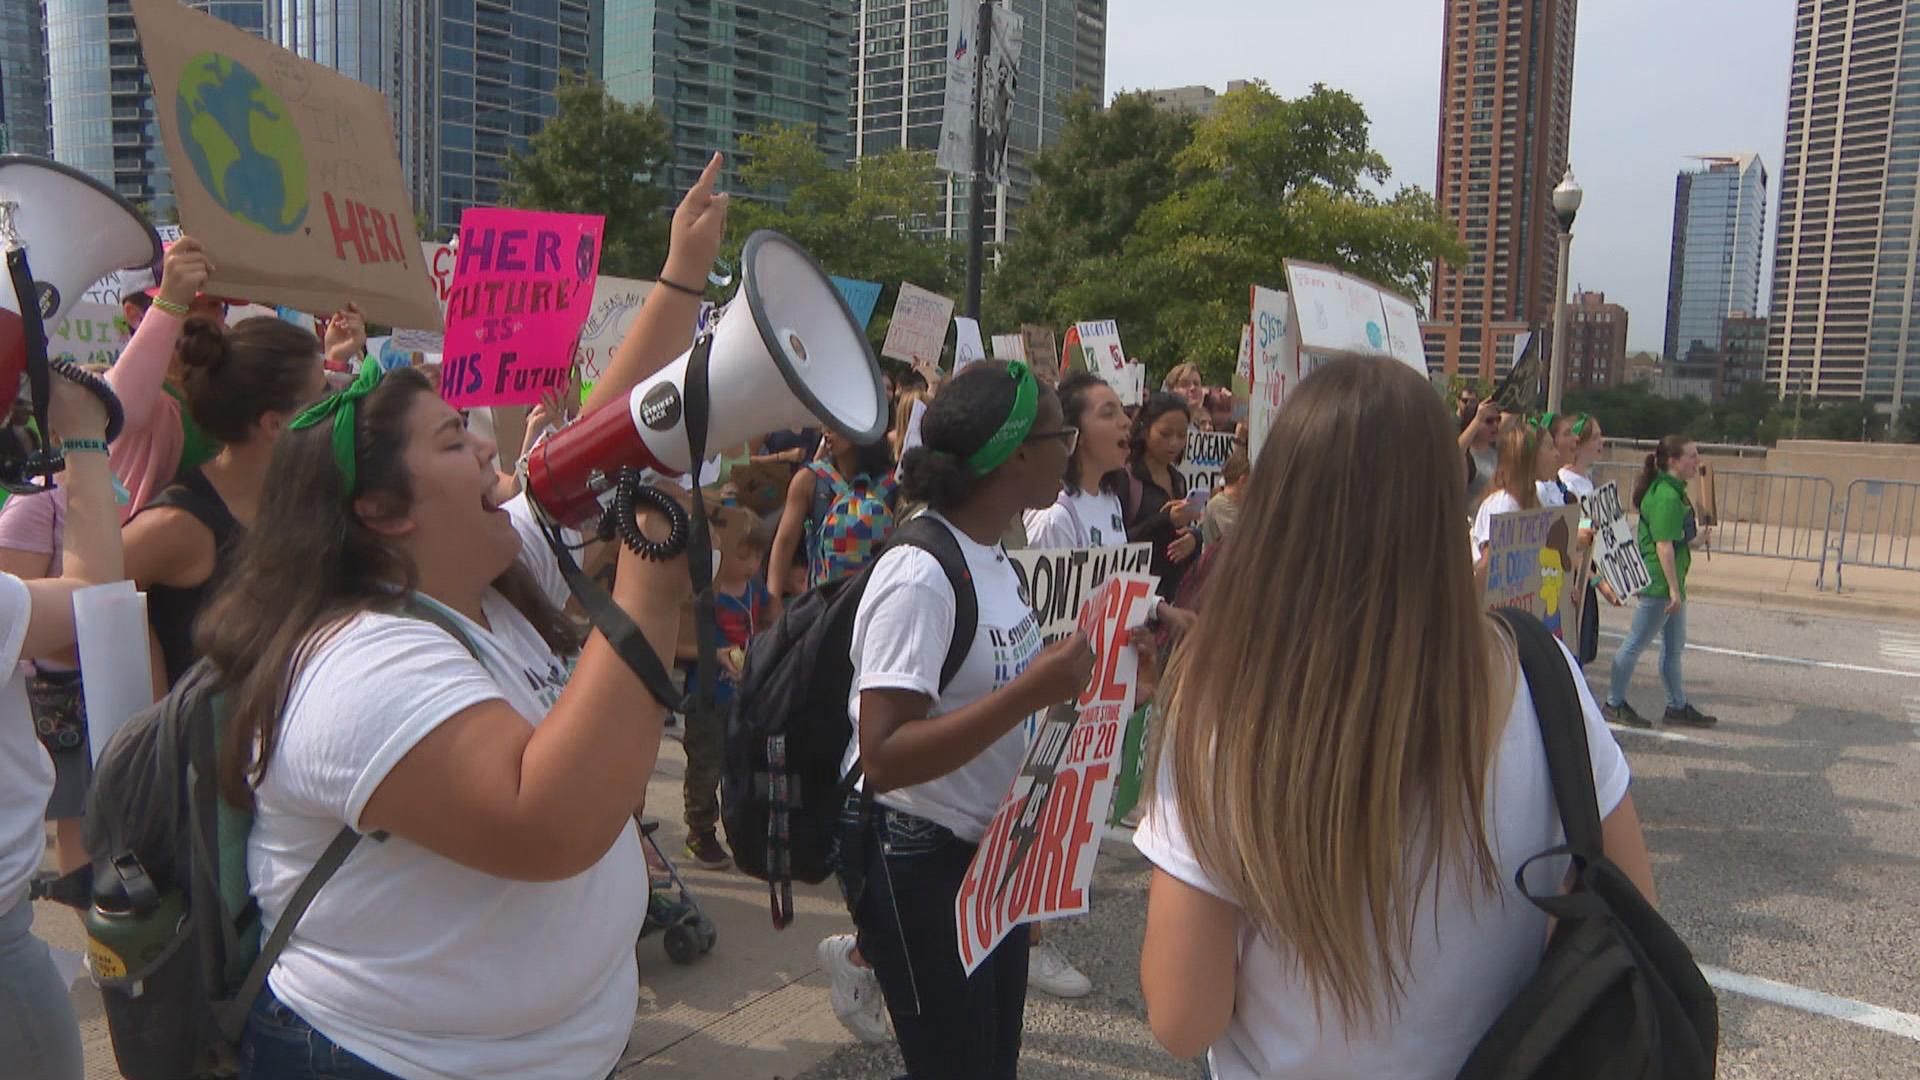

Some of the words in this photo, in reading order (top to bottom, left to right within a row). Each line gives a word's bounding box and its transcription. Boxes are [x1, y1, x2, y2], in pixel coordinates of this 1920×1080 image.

[322, 191, 409, 271] HER!
[459, 228, 562, 276] HER
[441, 352, 483, 401] HIS
[1193, 432, 1236, 463] OCEANS
[1066, 724, 1094, 765] SEP
[1093, 721, 1118, 760] 20
